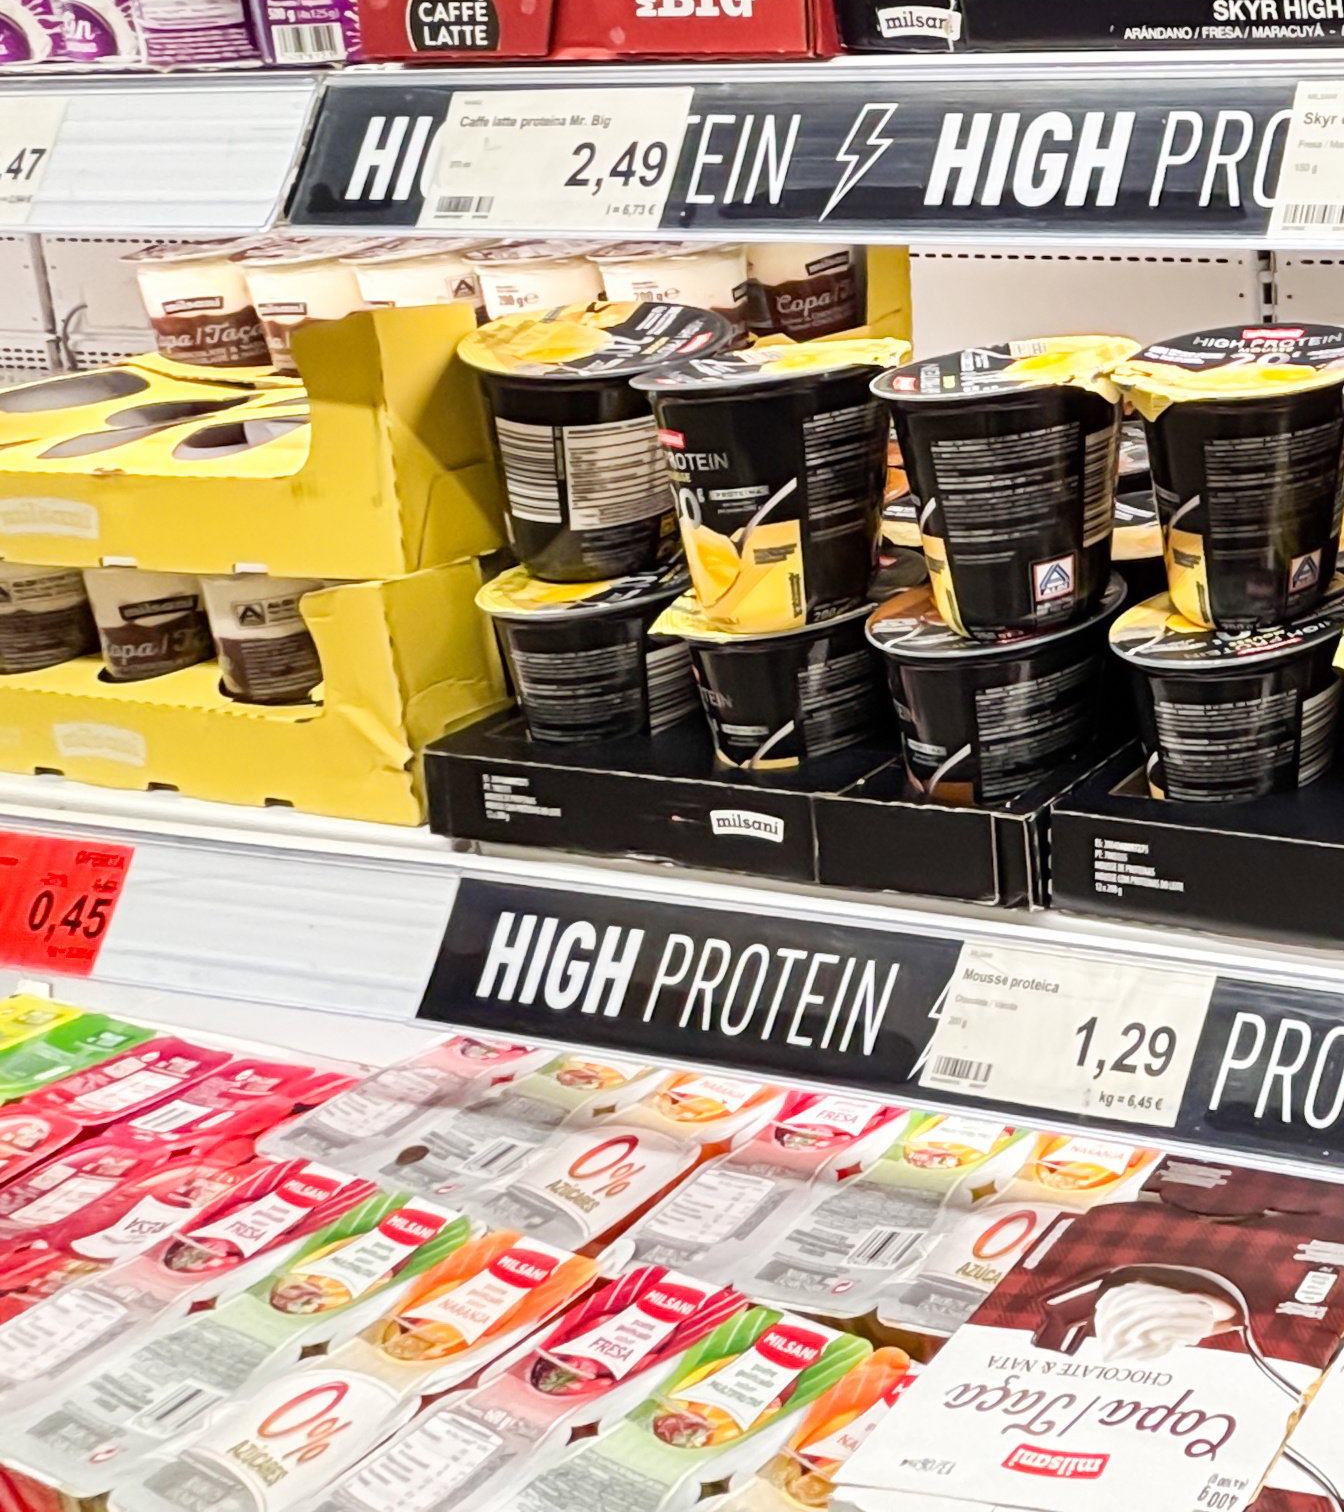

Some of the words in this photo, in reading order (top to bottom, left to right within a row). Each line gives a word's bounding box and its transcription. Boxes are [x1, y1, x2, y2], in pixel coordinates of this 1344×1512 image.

[424, 25, 488, 47] LATTE
[1124, 24, 1192, 40] ARÁNDANO
[1202, 25, 1242, 40] FRESA
[1252, 22, 1325, 39] MARACUYÁ
[492, 115, 517, 128] latte
[569, 115, 587, 127] Mr.
[1303, 111, 1337, 129] Skyr
[0, 147, 47, 181] 47
[344, 115, 436, 202] HI
[564, 140, 669, 196] 2,49
[924, 109, 1138, 209] HIGH
[717, 814, 781, 838] milsani
[29, 889, 112, 940] 0,45
[474, 912, 648, 1018] HIGH
[643, 932, 901, 1056] PROTEIN
[962, 967, 1009, 986] Mousse
[1009, 973, 1060, 994] proteica
[1075, 1016, 1177, 1080] 1,29
[1058, 1361, 1174, 1387] CHOCOLATE
[945, 1383, 1078, 1436] Taça
[1099, 1389, 1237, 1461] Copa
[1008, 1449, 1106, 1479] milsani
